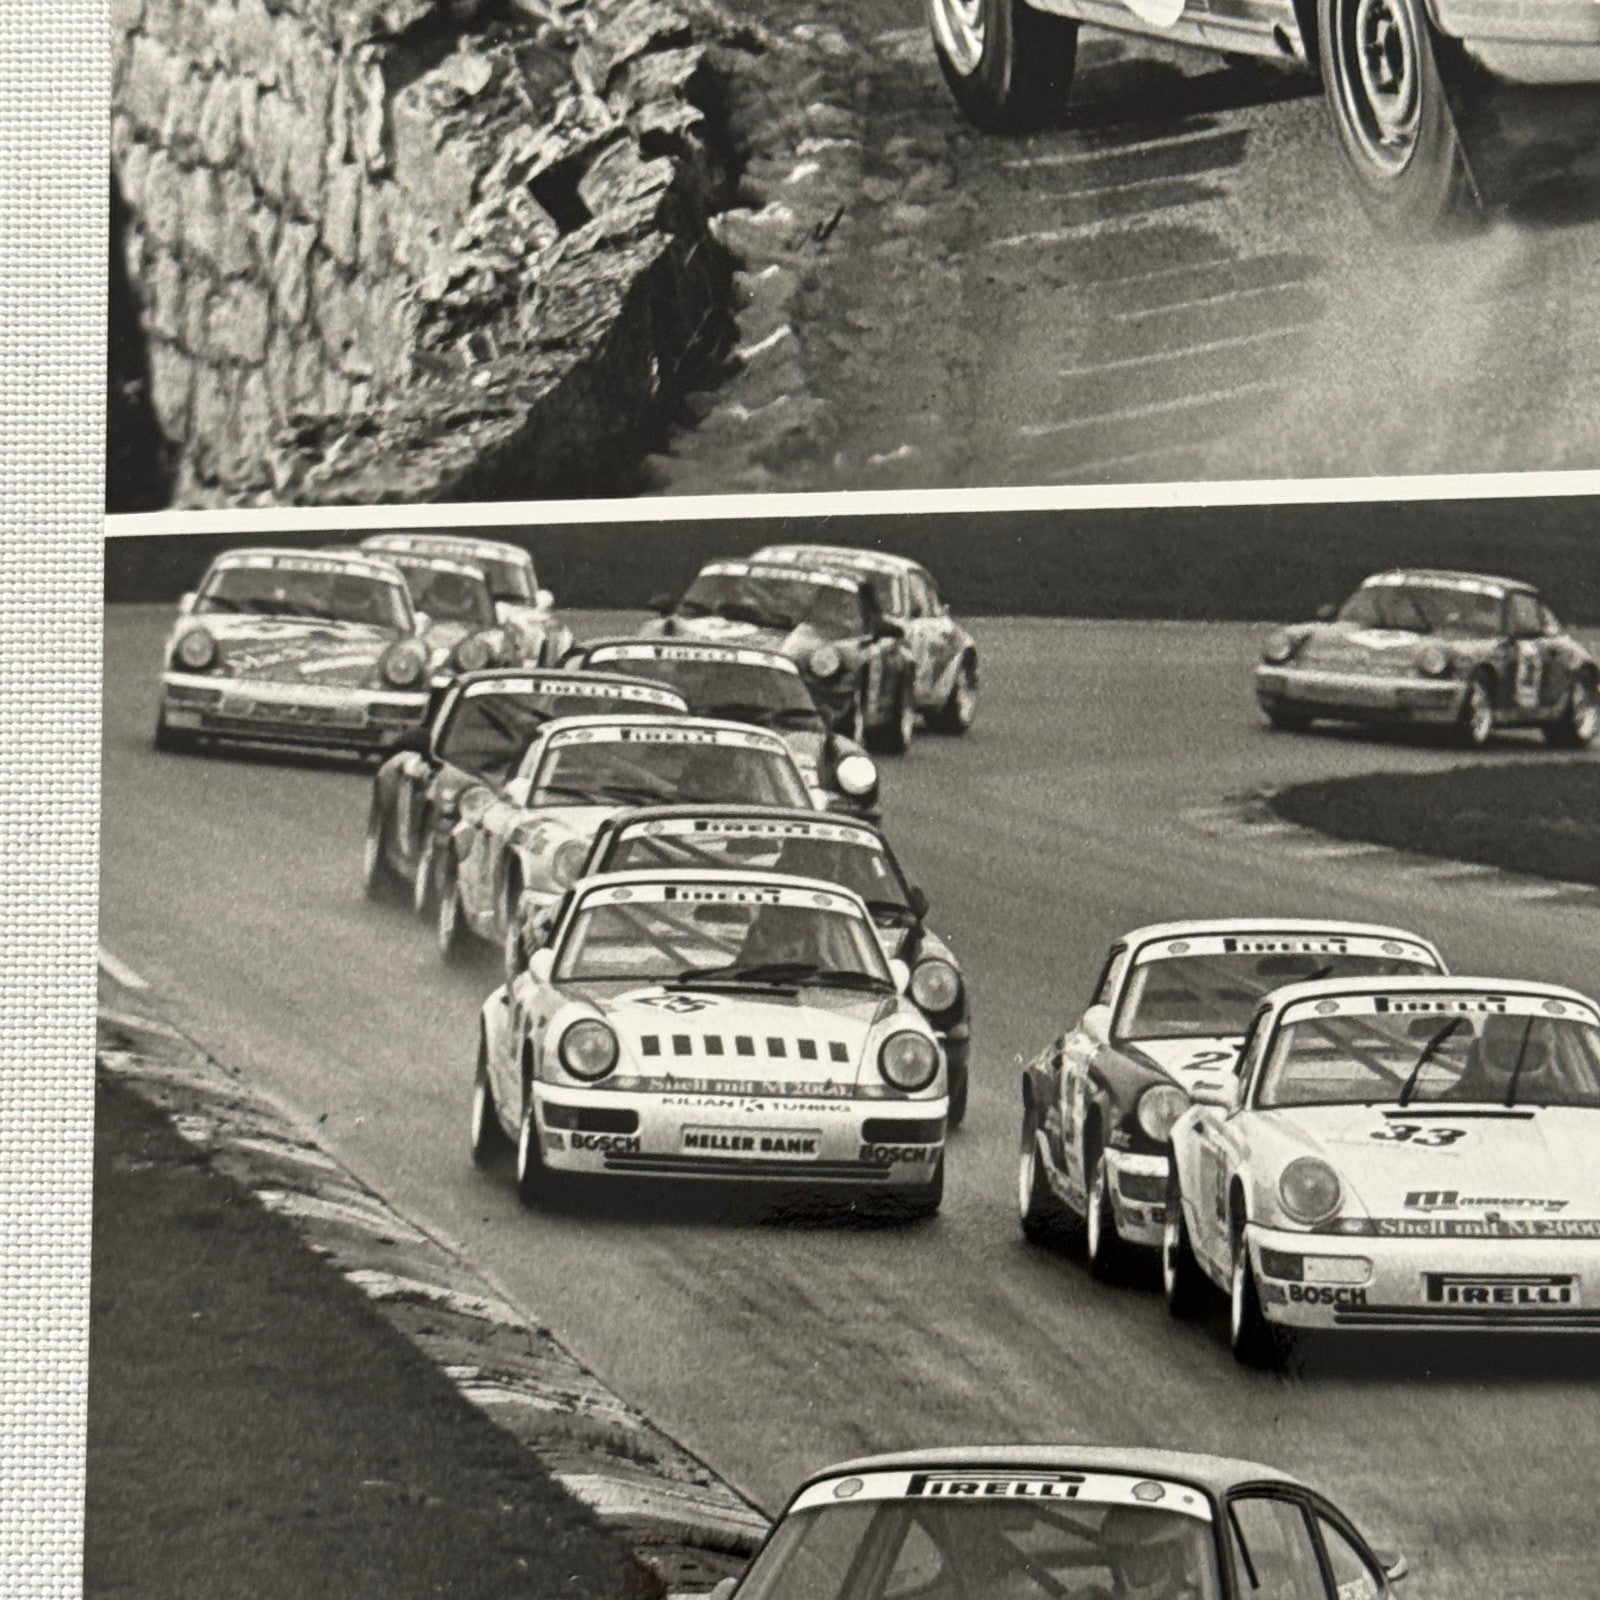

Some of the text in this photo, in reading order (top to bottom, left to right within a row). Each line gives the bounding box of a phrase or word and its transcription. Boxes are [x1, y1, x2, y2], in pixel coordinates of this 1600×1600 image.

[664, 885, 781, 903] PIRELLI
[1222, 938, 1348, 954] PIRELLI
[1373, 996, 1507, 1014] PIRELLI
[570, 1132, 641, 1153] BOSCH
[684, 1133, 817, 1153] HELLER BANK
[1369, 1123, 1468, 1147] 33
[859, 1145, 928, 1164] BOSCH
[1378, 1219, 1447, 1236] Shell
[1454, 1219, 1500, 1236] mit
[1288, 1283, 1367, 1305] BOSCH
[1426, 1272, 1574, 1304] PIRELLI
[904, 1472, 1086, 1498] PIRELLI
